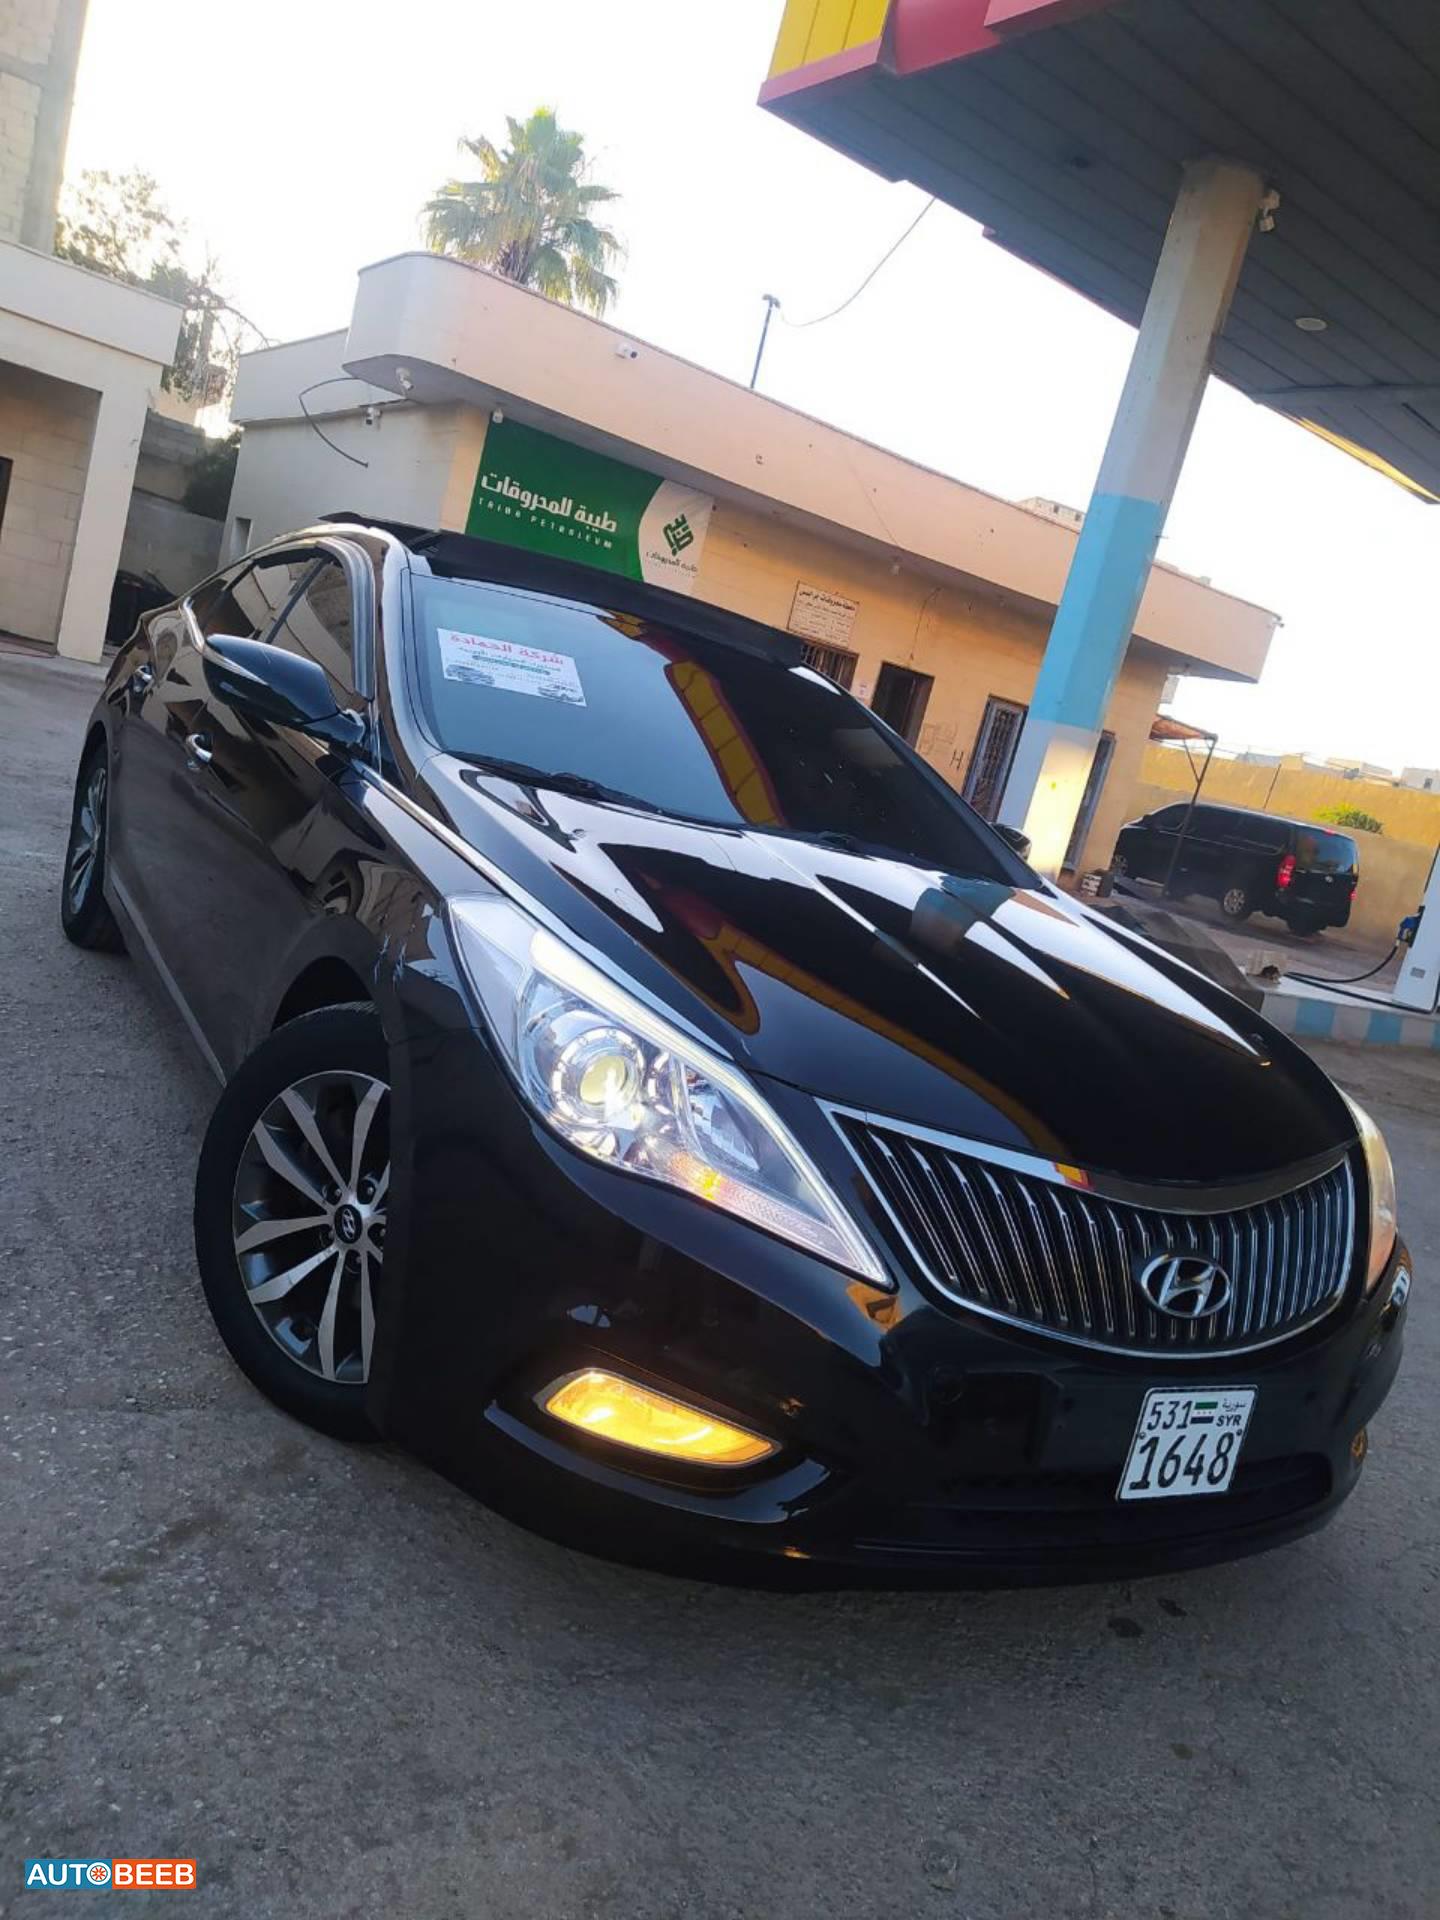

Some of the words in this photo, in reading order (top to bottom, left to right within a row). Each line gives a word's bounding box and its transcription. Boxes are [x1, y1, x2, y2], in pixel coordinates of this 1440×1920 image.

[481, 472, 573, 517] للمحروقات
[530, 515, 612, 549] PETROLEUM
[574, 505, 617, 533] طيبة
[519, 647, 564, 665] شركة
[1146, 1400, 1193, 1431] 531
[1216, 1414, 1242, 1427] SYR
[1129, 1432, 1234, 1491] 1648
